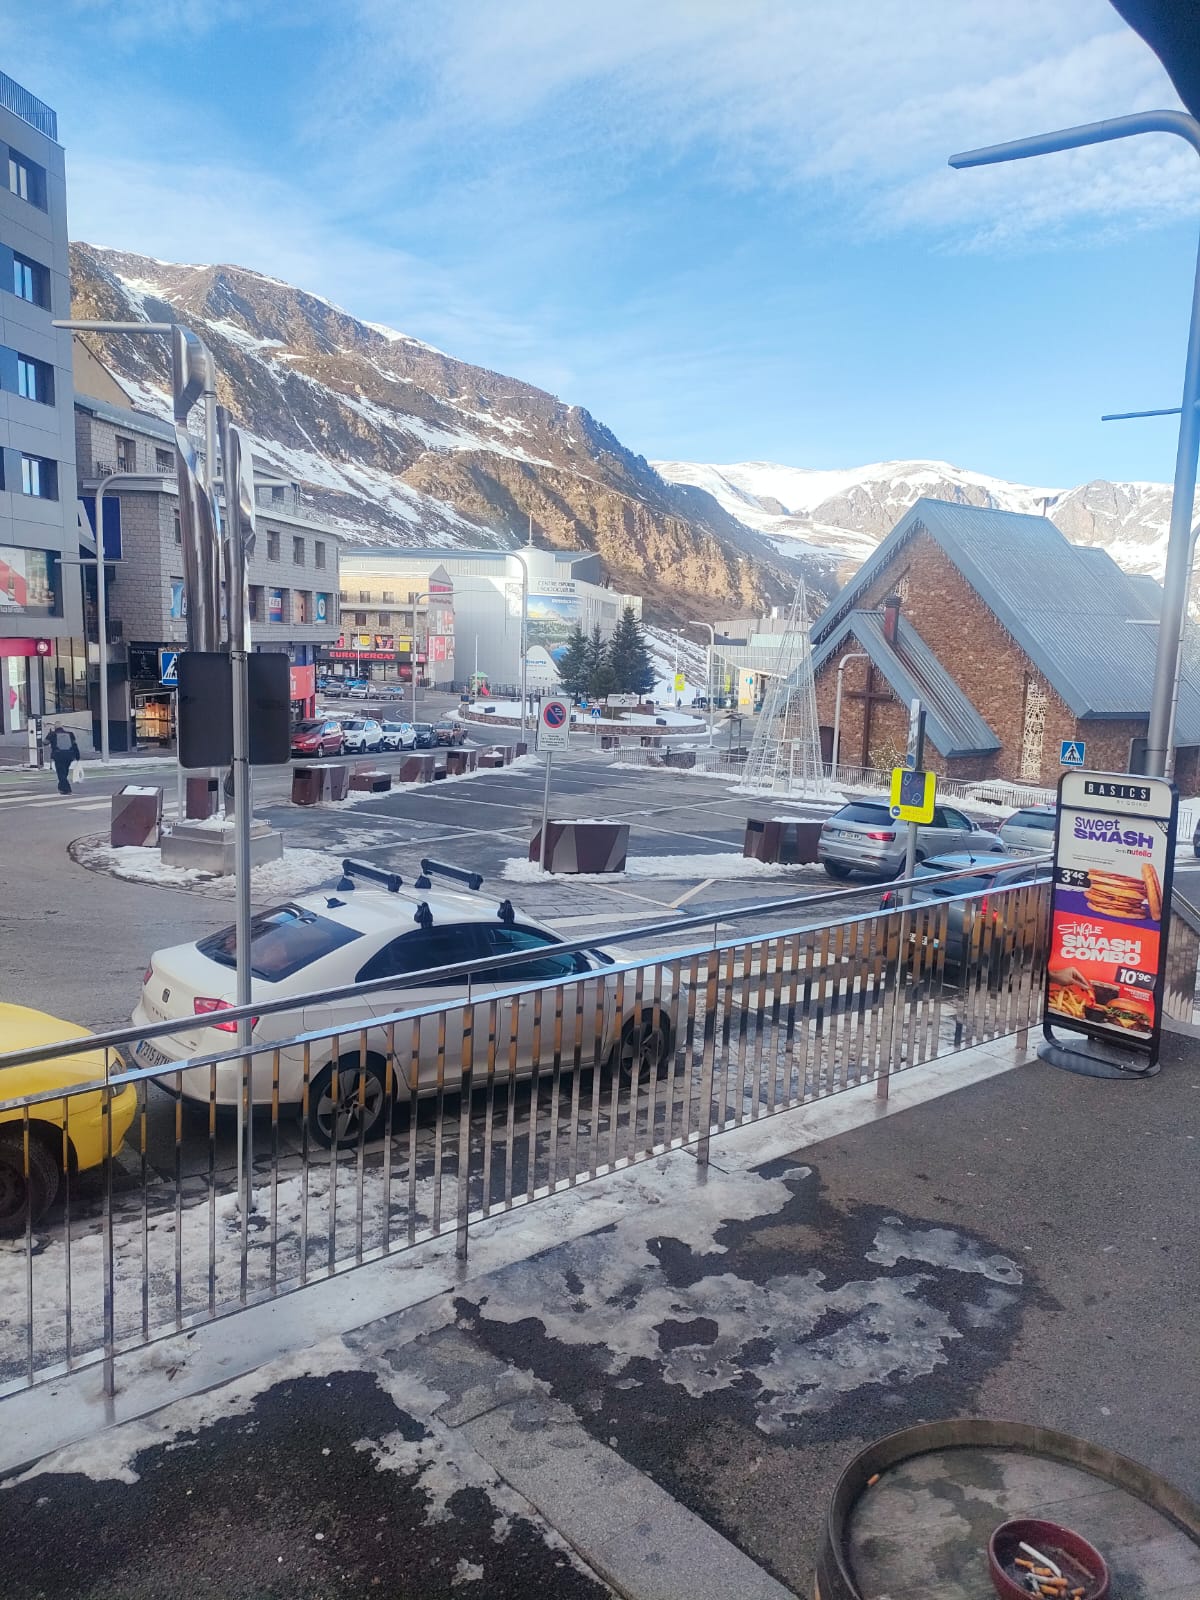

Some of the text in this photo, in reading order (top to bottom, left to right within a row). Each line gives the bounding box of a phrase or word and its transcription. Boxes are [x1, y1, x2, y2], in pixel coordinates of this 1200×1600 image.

[329, 651, 396, 660] EUROMERCAT
[1088, 783, 1147, 799] BASICS
[1073, 828, 1154, 849] SMASH
[1126, 849, 1152, 858] nutella
[1062, 934, 1142, 954] SMASH
[1060, 946, 1141, 966] COMBO
